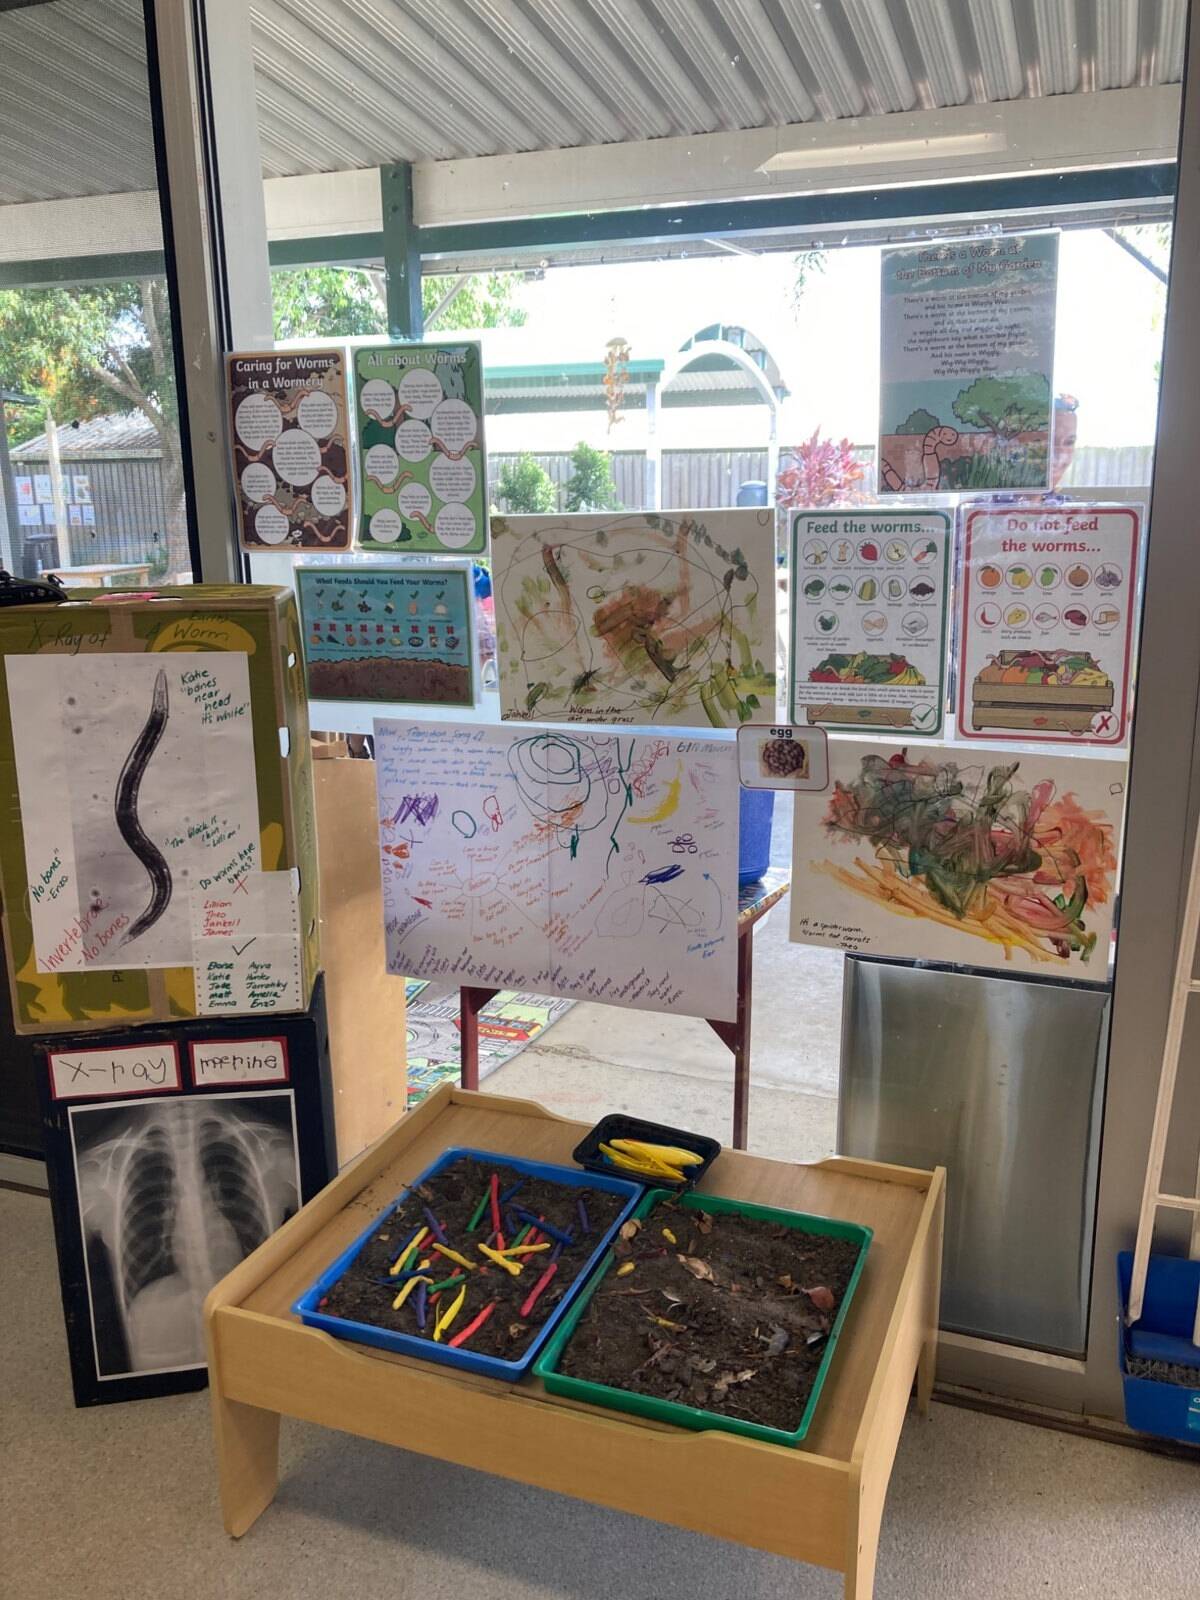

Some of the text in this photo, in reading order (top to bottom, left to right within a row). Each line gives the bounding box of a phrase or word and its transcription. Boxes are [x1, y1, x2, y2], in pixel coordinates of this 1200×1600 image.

[235, 357, 335, 375] Caring for Worms
[367, 352, 467, 366] All about Worms
[248, 376, 324, 390] in a Wormery
[807, 521, 936, 534] Feed the worms...
[1007, 516, 1099, 535] Do not feed
[1001, 539, 1102, 553] the worms...
[316, 577, 333, 585] What
[334, 577, 353, 585] Foods
[354, 577, 375, 585] Should
[422, 578, 448, 586] Worms?
[90, 631, 109, 648] of
[173, 623, 230, 643] Worm
[181, 669, 210, 685] Katie
[195, 689, 221, 704] near
[204, 693, 231, 711] head
[569, 704, 593, 714] Worm
[606, 705, 623, 714] the
[769, 728, 793, 738] egg
[199, 843, 256, 890] Do worms have
[227, 855, 255, 884] bones?
[96, 913, 130, 947] bones
[209, 1000, 237, 1008] Emma
[250, 999, 276, 1008] Enzo
